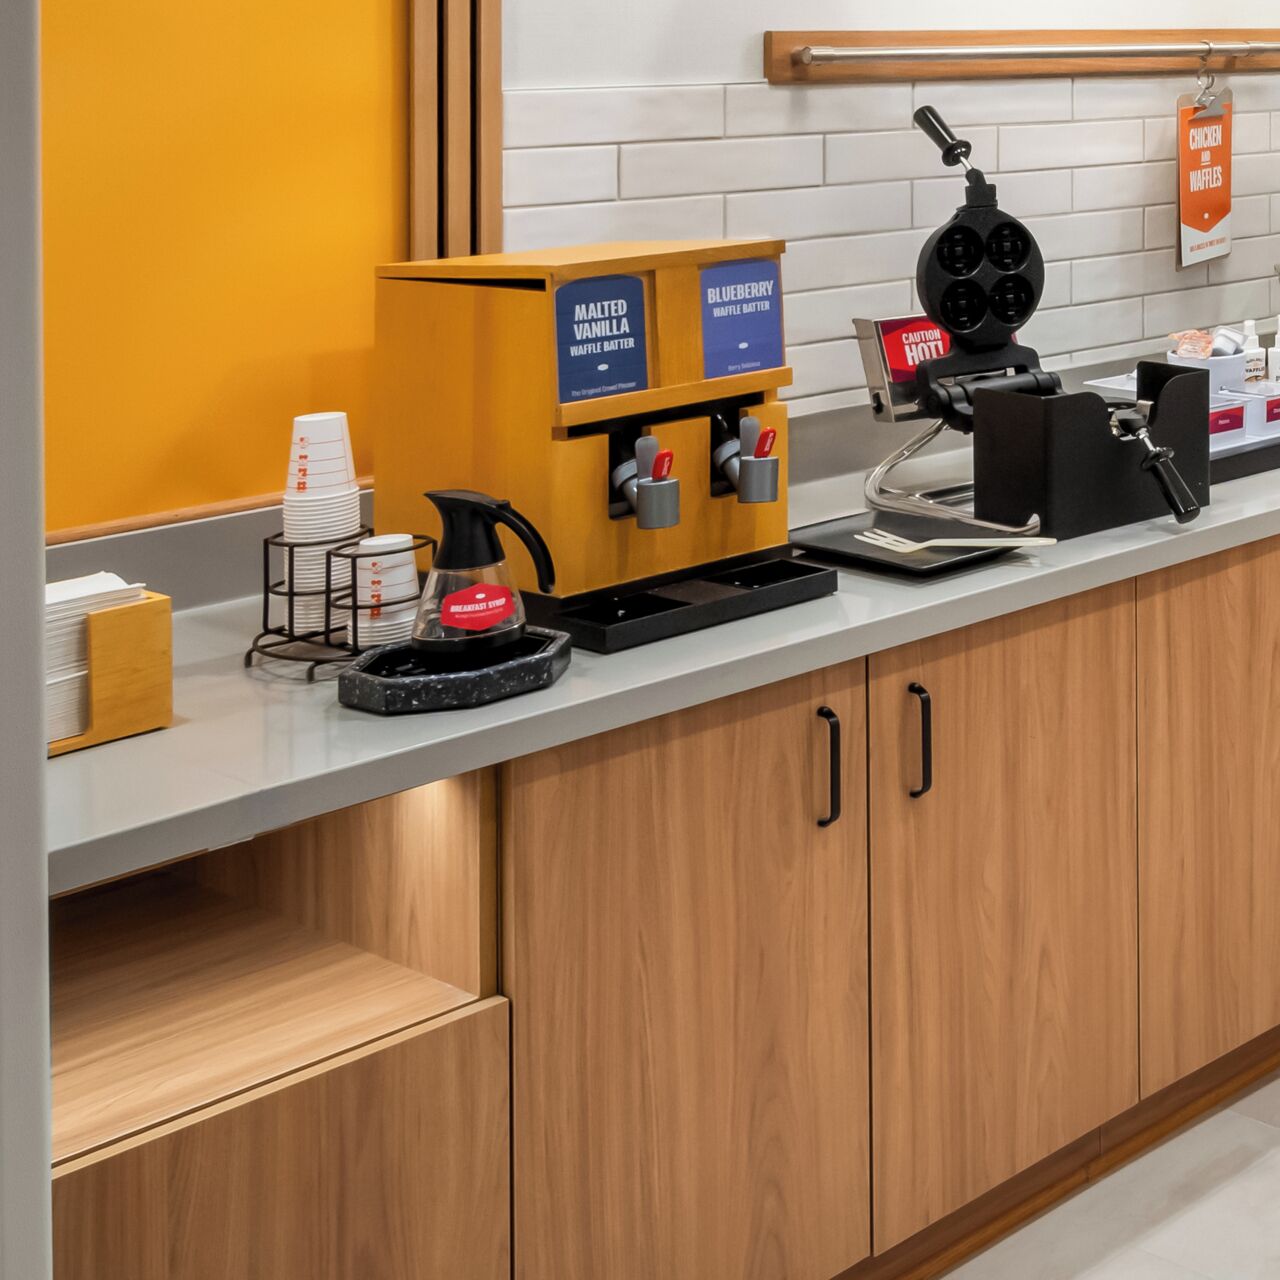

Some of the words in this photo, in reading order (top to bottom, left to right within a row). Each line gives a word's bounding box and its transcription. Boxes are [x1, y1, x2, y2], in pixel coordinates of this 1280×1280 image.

[1189, 125, 1222, 150] CHICKEN
[1200, 150, 1211, 163] AND
[1189, 166, 1222, 192] WAFFLES
[707, 280, 774, 304] BLUEBERRY
[574, 299, 628, 322] MALTED
[713, 305, 741, 318] WAFFLE
[742, 300, 770, 314] BATTER
[573, 317, 630, 341] VANILLA
[902, 329, 941, 344] CAUTION
[570, 342, 602, 357] WAFFLE
[603, 337, 635, 352] BATTER
[904, 340, 944, 366] HOT!
[450, 602, 487, 613] BREAKFAST
